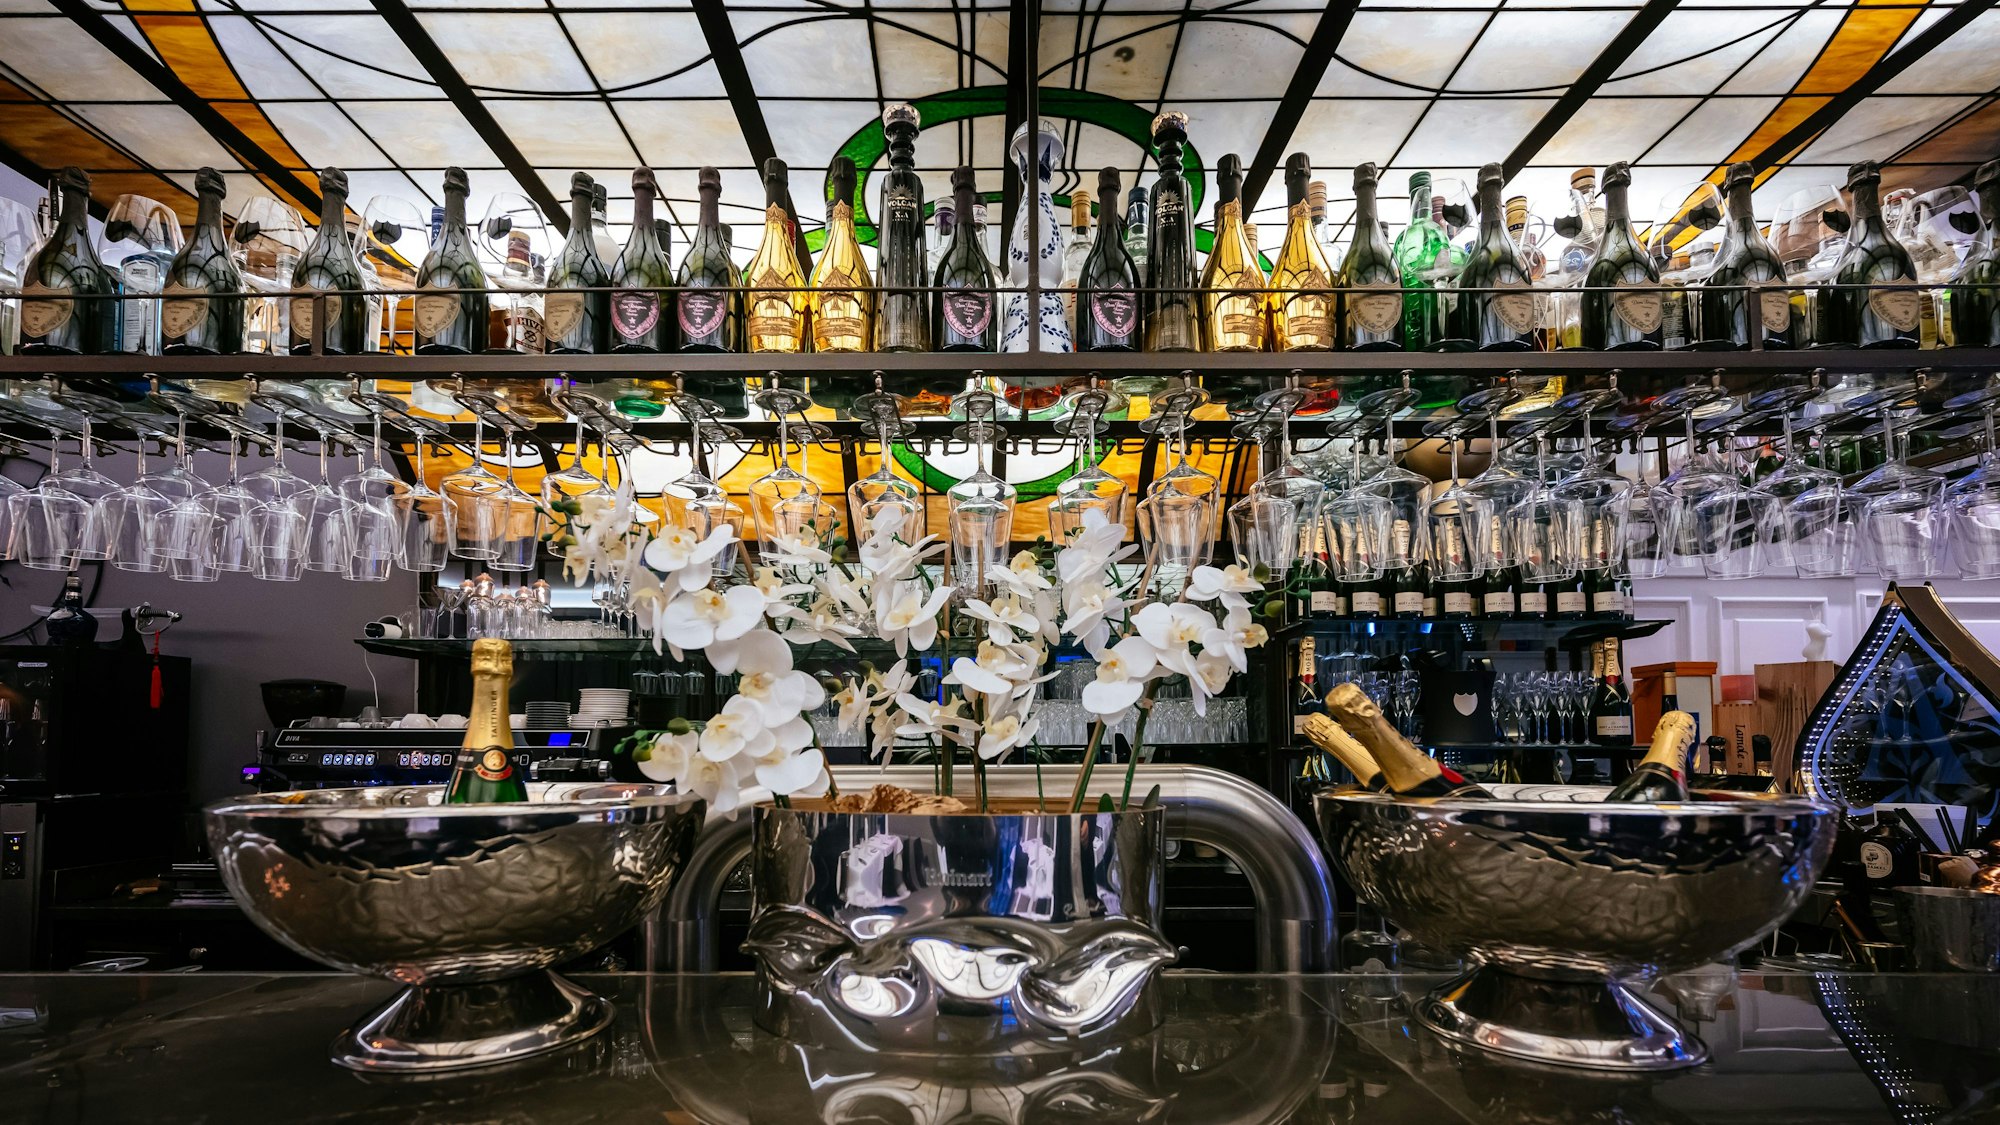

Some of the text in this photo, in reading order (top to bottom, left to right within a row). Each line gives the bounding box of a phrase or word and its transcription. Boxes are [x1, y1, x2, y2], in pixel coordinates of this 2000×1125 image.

[888, 200, 917, 209] VOLCAN
[519, 317, 543, 331] HIVA
[1735, 724, 1748, 759] Lamole
[925, 868, 992, 887] Ruinart
